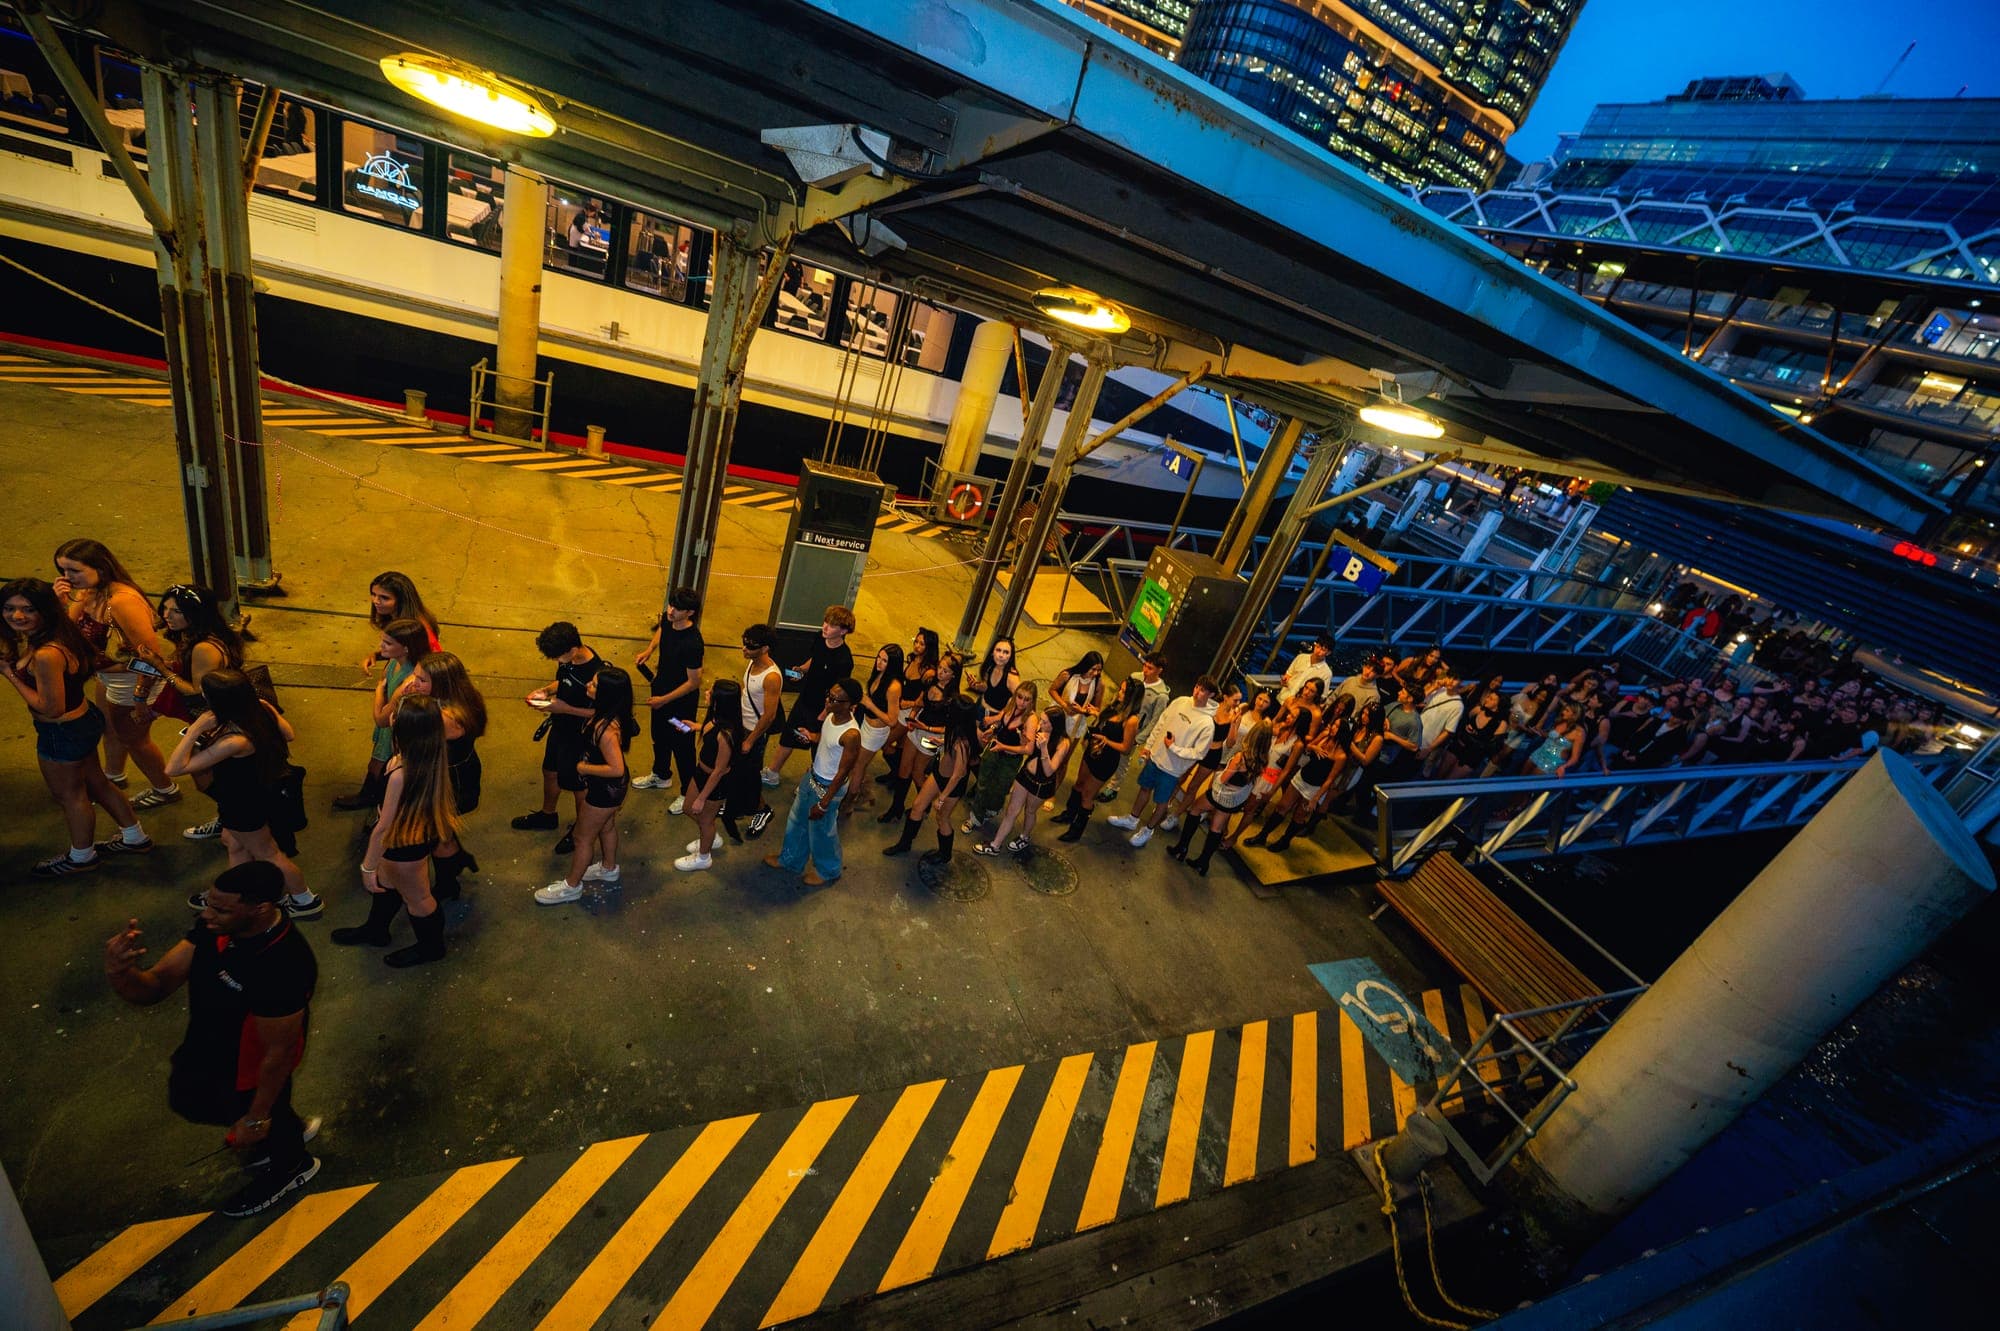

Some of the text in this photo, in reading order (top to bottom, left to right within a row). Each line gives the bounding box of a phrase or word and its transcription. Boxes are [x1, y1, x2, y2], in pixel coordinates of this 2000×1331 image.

[1169, 455, 1181, 475] A
[814, 534, 866, 550] Next service
[1342, 556, 1364, 582] B
